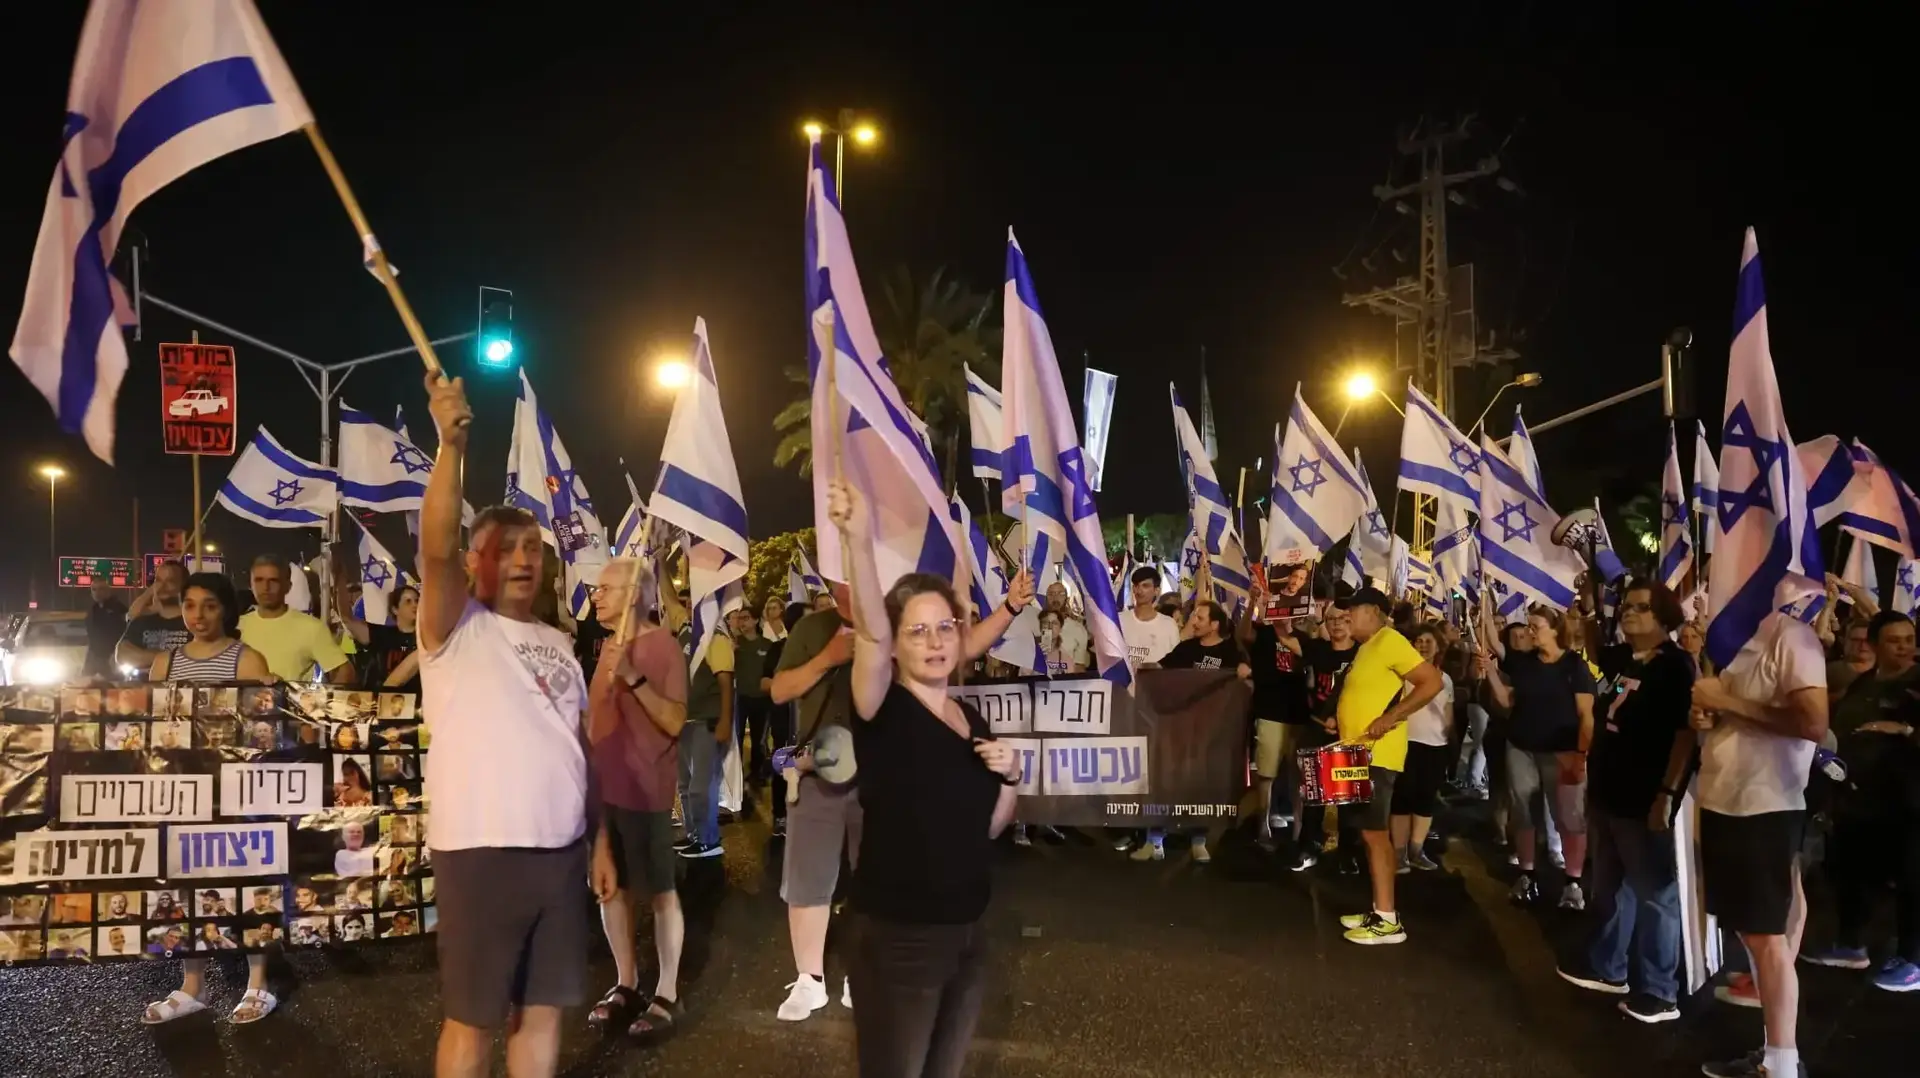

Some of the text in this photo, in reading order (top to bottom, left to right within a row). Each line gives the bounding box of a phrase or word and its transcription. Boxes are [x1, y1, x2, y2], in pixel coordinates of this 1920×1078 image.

[163, 347, 232, 366] בחירות
[1041, 690, 1105, 723] חברי
[1048, 746, 1141, 785] עכשיו
[75, 780, 198, 816] השבויים
[236, 770, 307, 811] פדיון
[1106, 802, 1140, 816] למדינה
[1216, 804, 1238, 818] פדיון
[28, 832, 146, 876] למדינה
[178, 830, 274, 874] ניצחון
